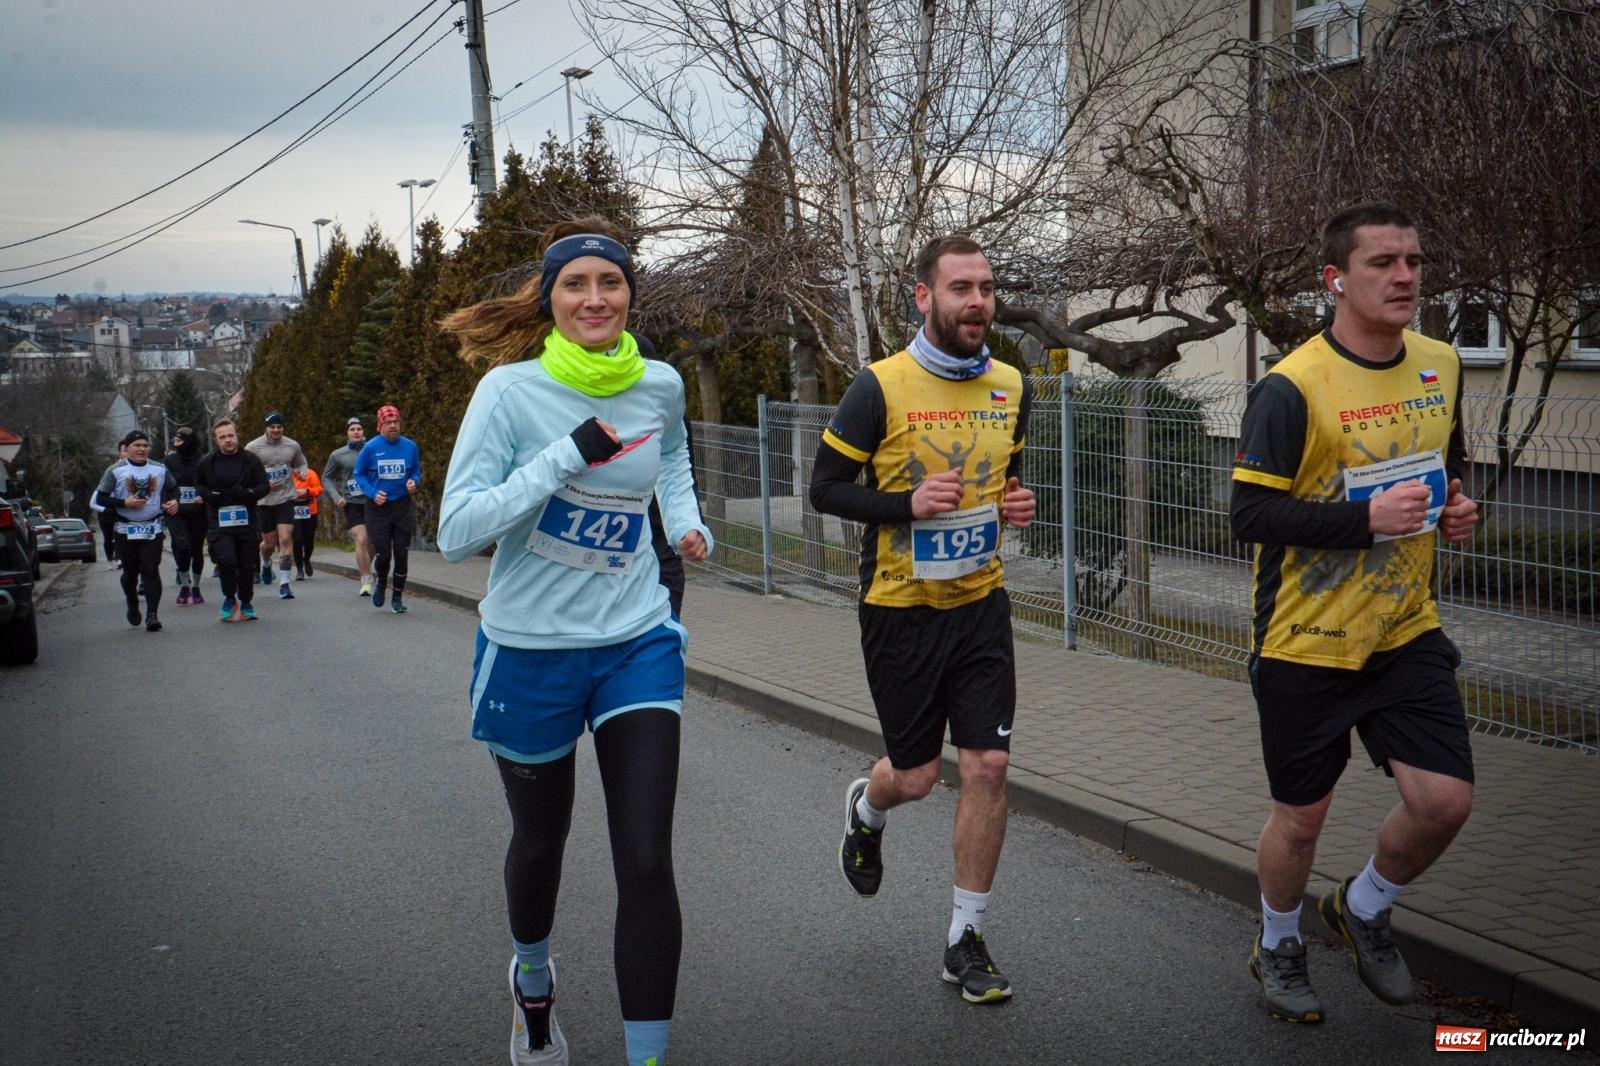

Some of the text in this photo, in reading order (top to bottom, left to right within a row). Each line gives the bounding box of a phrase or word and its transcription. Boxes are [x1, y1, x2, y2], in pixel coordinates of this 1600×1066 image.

[1343, 407, 1448, 433] BOLATICE
[908, 422, 1008, 432] BOLATICE
[383, 465, 401, 474] 110
[230, 511, 237, 520] 8
[134, 525, 151, 534] 102
[560, 509, 629, 549] 142
[930, 525, 986, 559] 195
